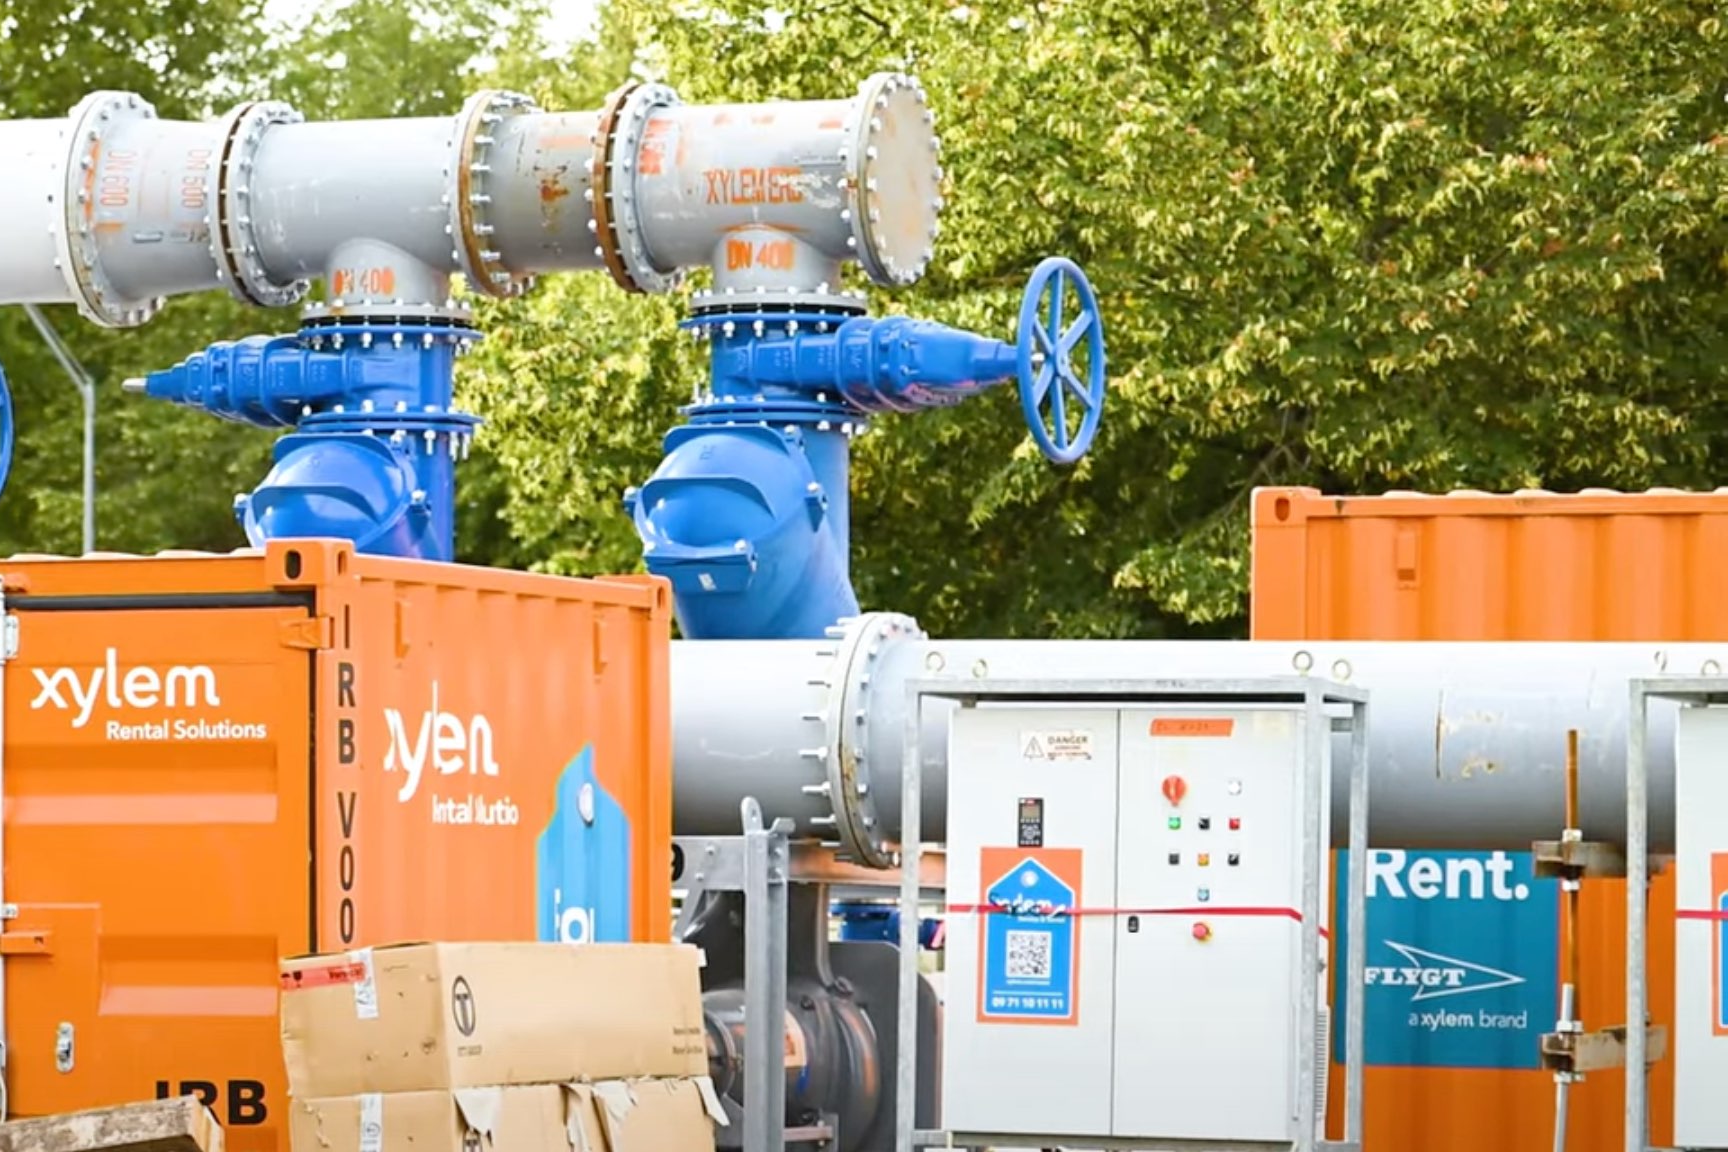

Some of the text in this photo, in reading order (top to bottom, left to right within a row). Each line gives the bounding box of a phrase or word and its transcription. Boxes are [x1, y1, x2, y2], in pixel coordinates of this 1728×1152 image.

[727, 240, 795, 271] DN 400
[334, 267, 395, 297] DN 400
[29, 647, 221, 728] xylem
[105, 718, 268, 740] Rental Solutions
[1047, 735, 1089, 744] DANGER
[1365, 849, 1530, 900] Rent.
[1364, 966, 1466, 986] FLYGT
[1408, 1008, 1528, 1031] a xylem brand
